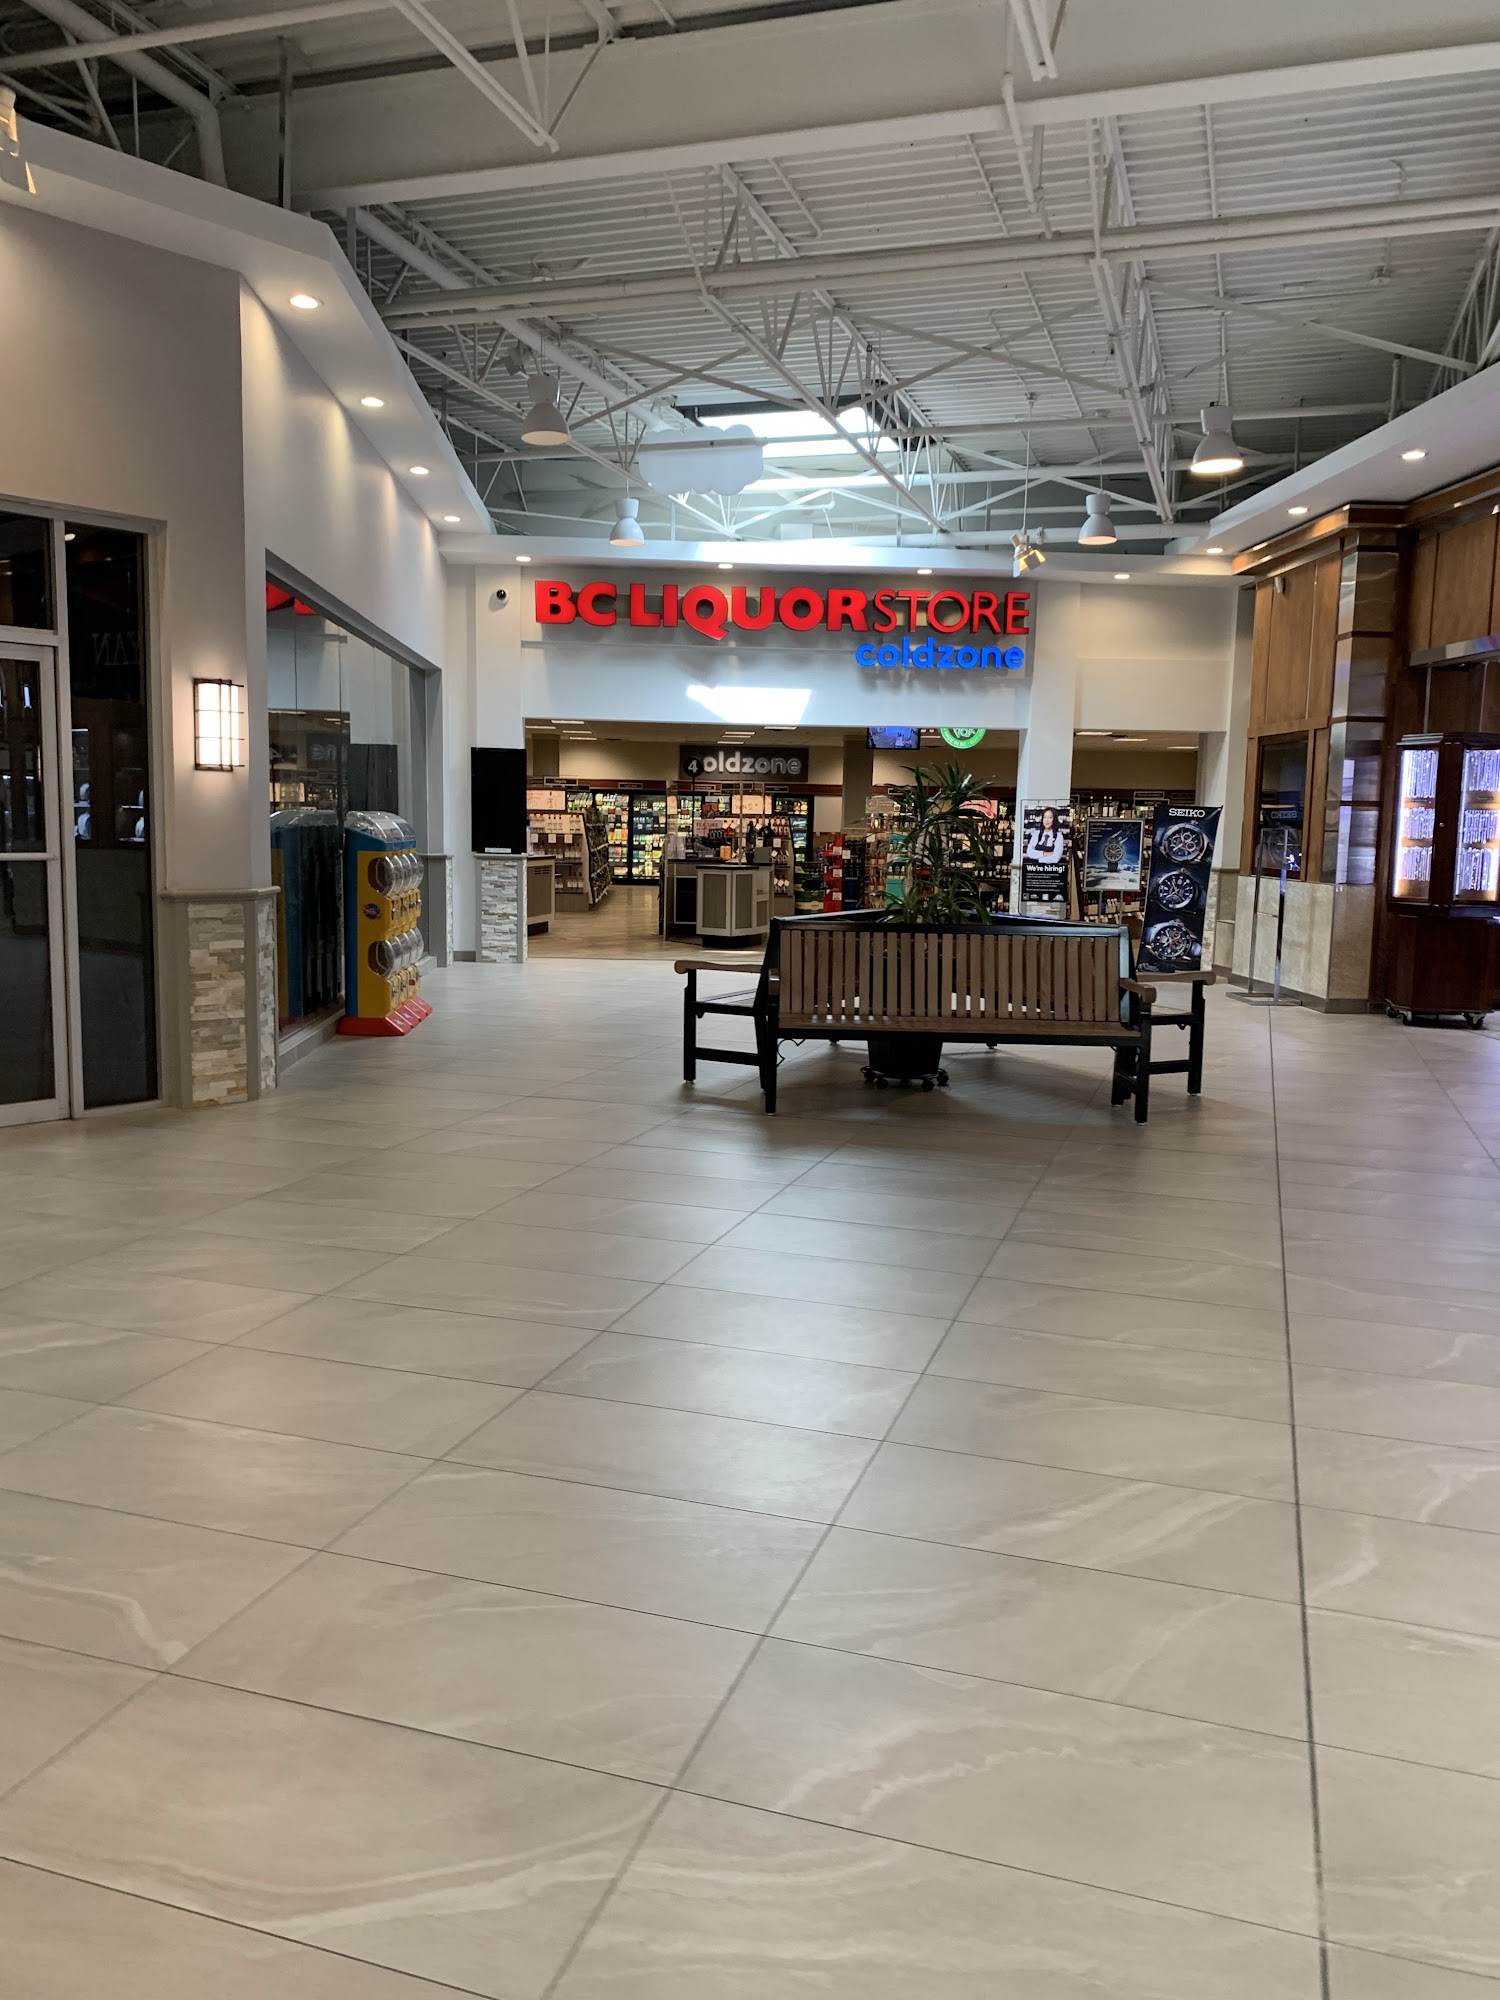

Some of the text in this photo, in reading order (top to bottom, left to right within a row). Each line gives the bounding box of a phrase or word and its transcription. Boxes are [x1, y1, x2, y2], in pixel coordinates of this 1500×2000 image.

[534, 579, 617, 627] BC
[855, 636, 1024, 670] coldzone
[687, 759, 699, 773] 4
[703, 750, 802, 775] oldzone
[1168, 807, 1206, 818] SEIKO
[1026, 864, 1066, 873] We're hiring!
